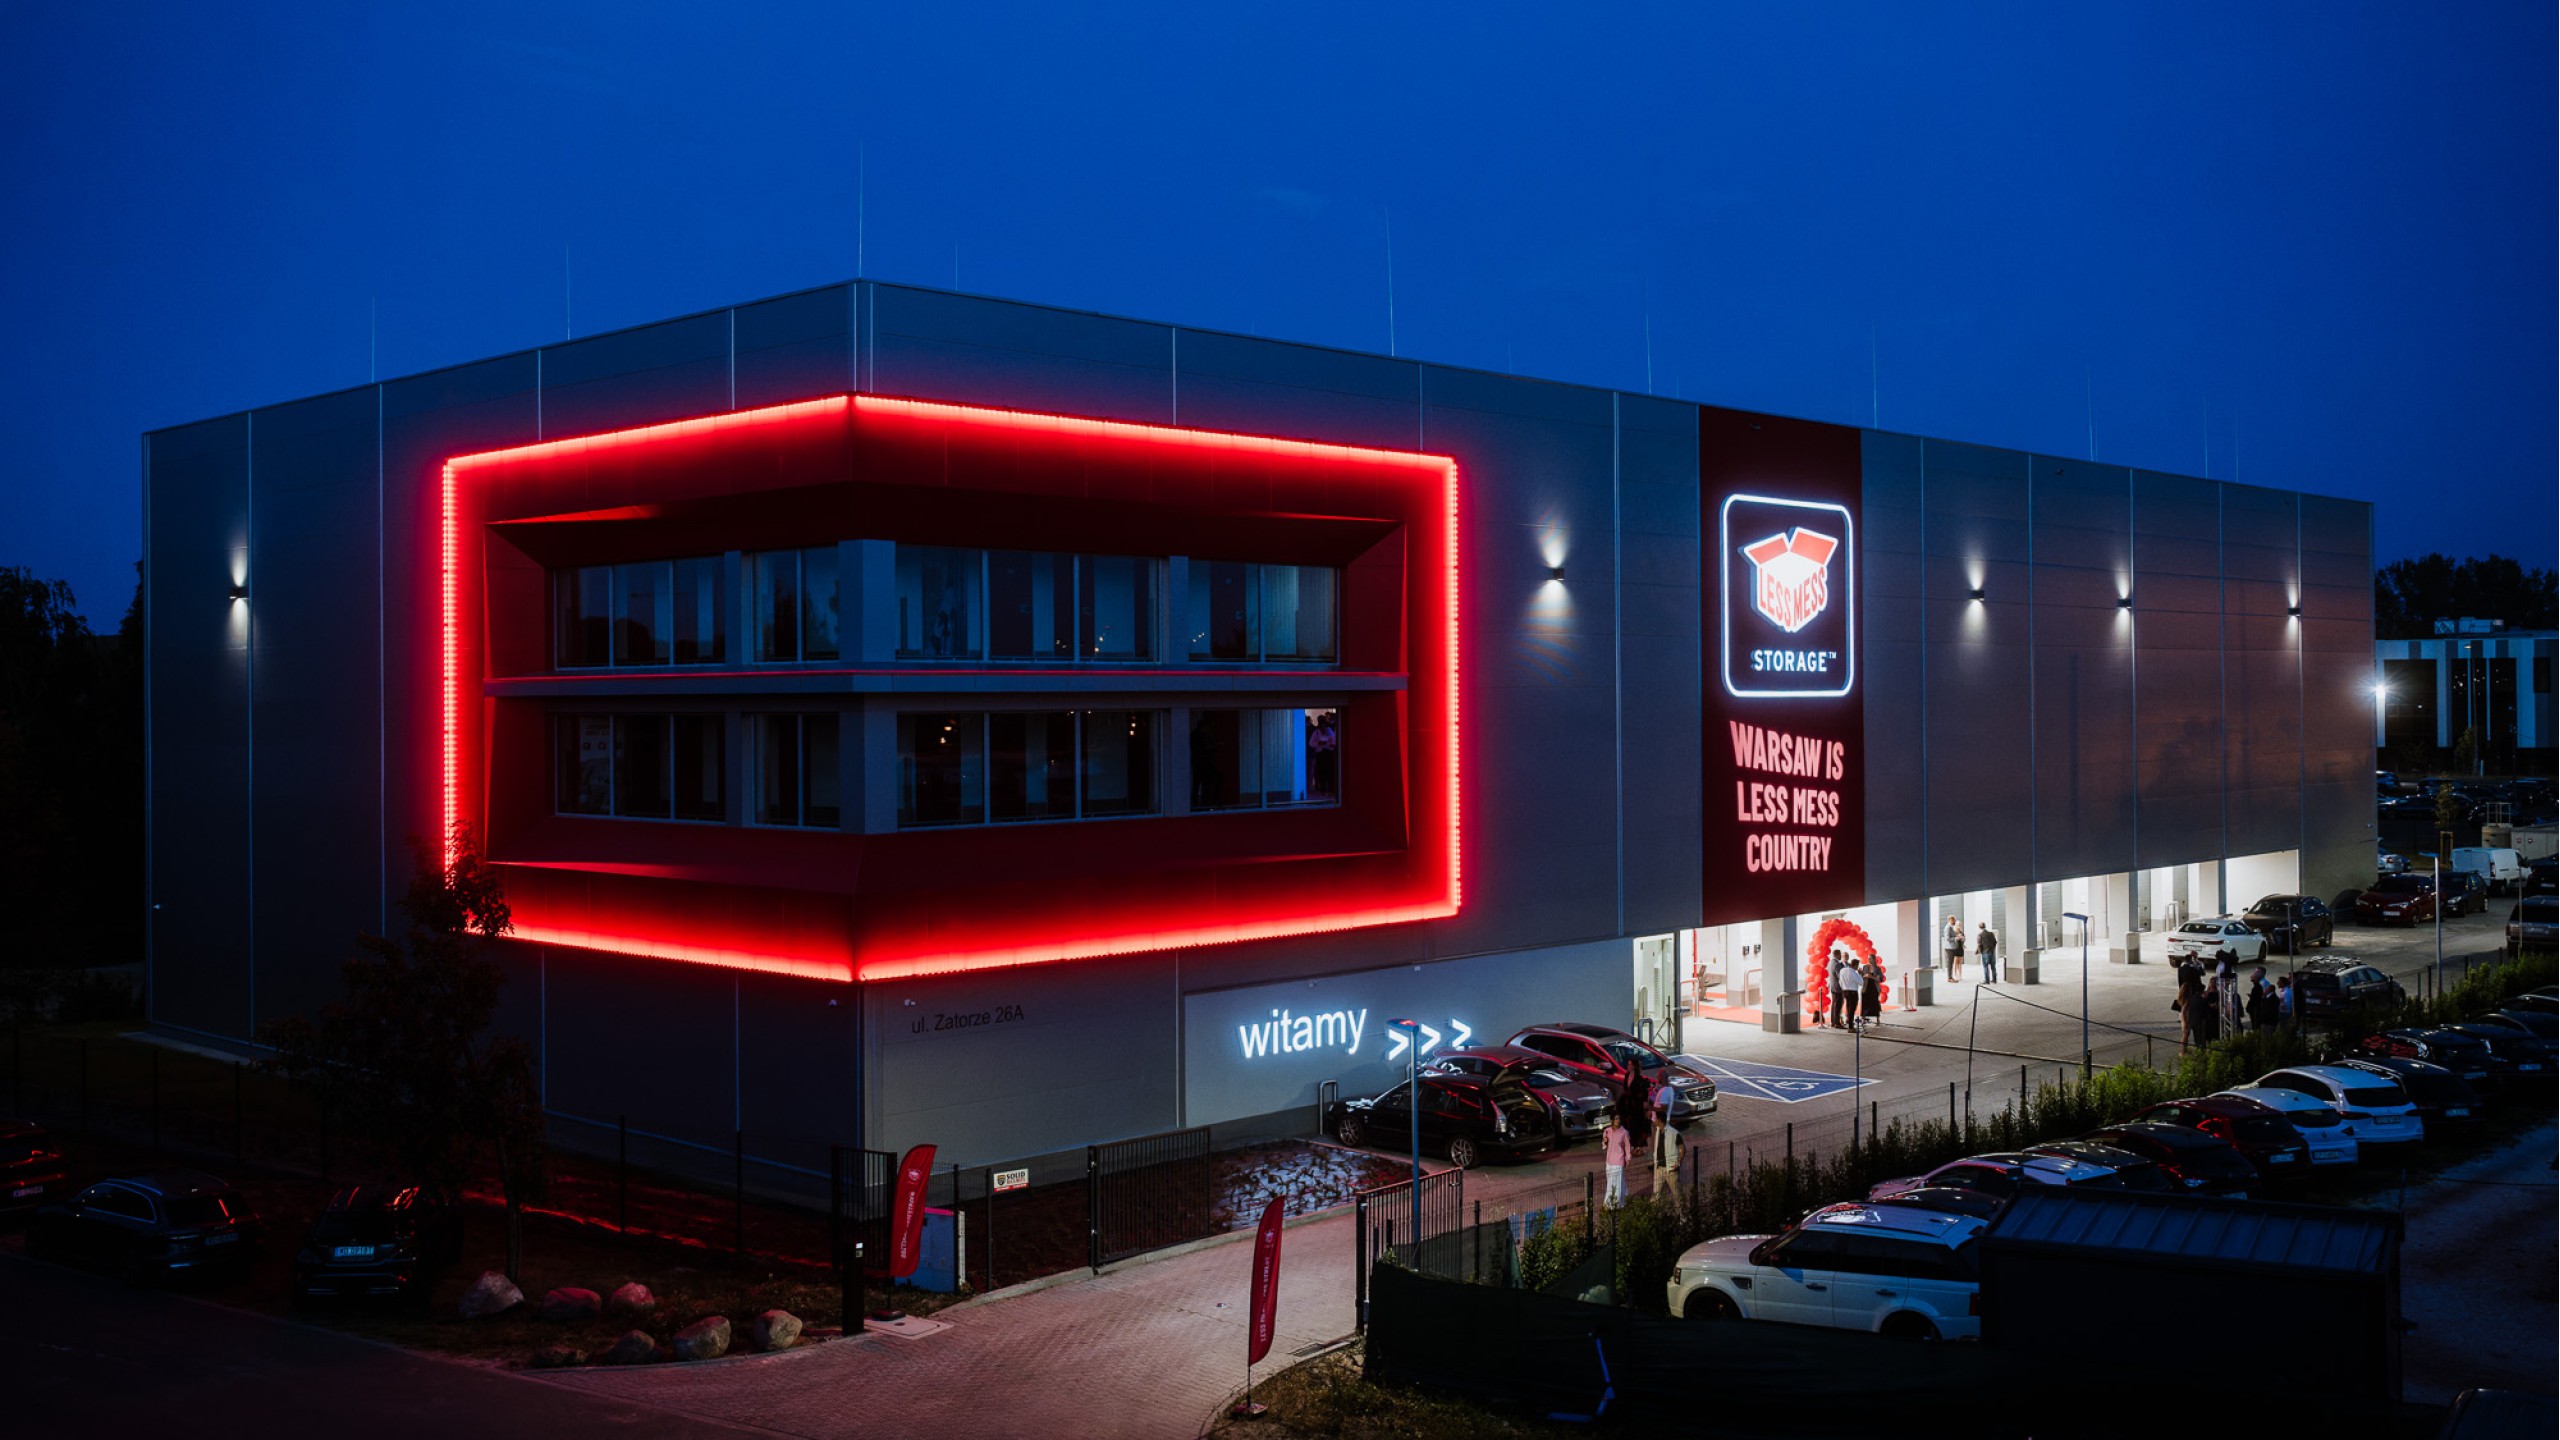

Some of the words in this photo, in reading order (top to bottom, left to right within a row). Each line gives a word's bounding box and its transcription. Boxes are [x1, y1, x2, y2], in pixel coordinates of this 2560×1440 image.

[1759, 567, 1791, 627] LESS
[1793, 566, 1826, 627] MESS
[1729, 720, 1822, 778] WARSAW
[1825, 740, 1845, 781] IS
[1736, 780, 1789, 823] LESS
[1793, 787, 1840, 827] MESS
[1746, 834, 1832, 873] COUNTRY
[911, 1017, 929, 1034] ul.
[934, 1011, 991, 1031] Zatorze
[995, 1005, 1024, 1024] 26A
[1239, 1008, 1367, 1059] witamy
